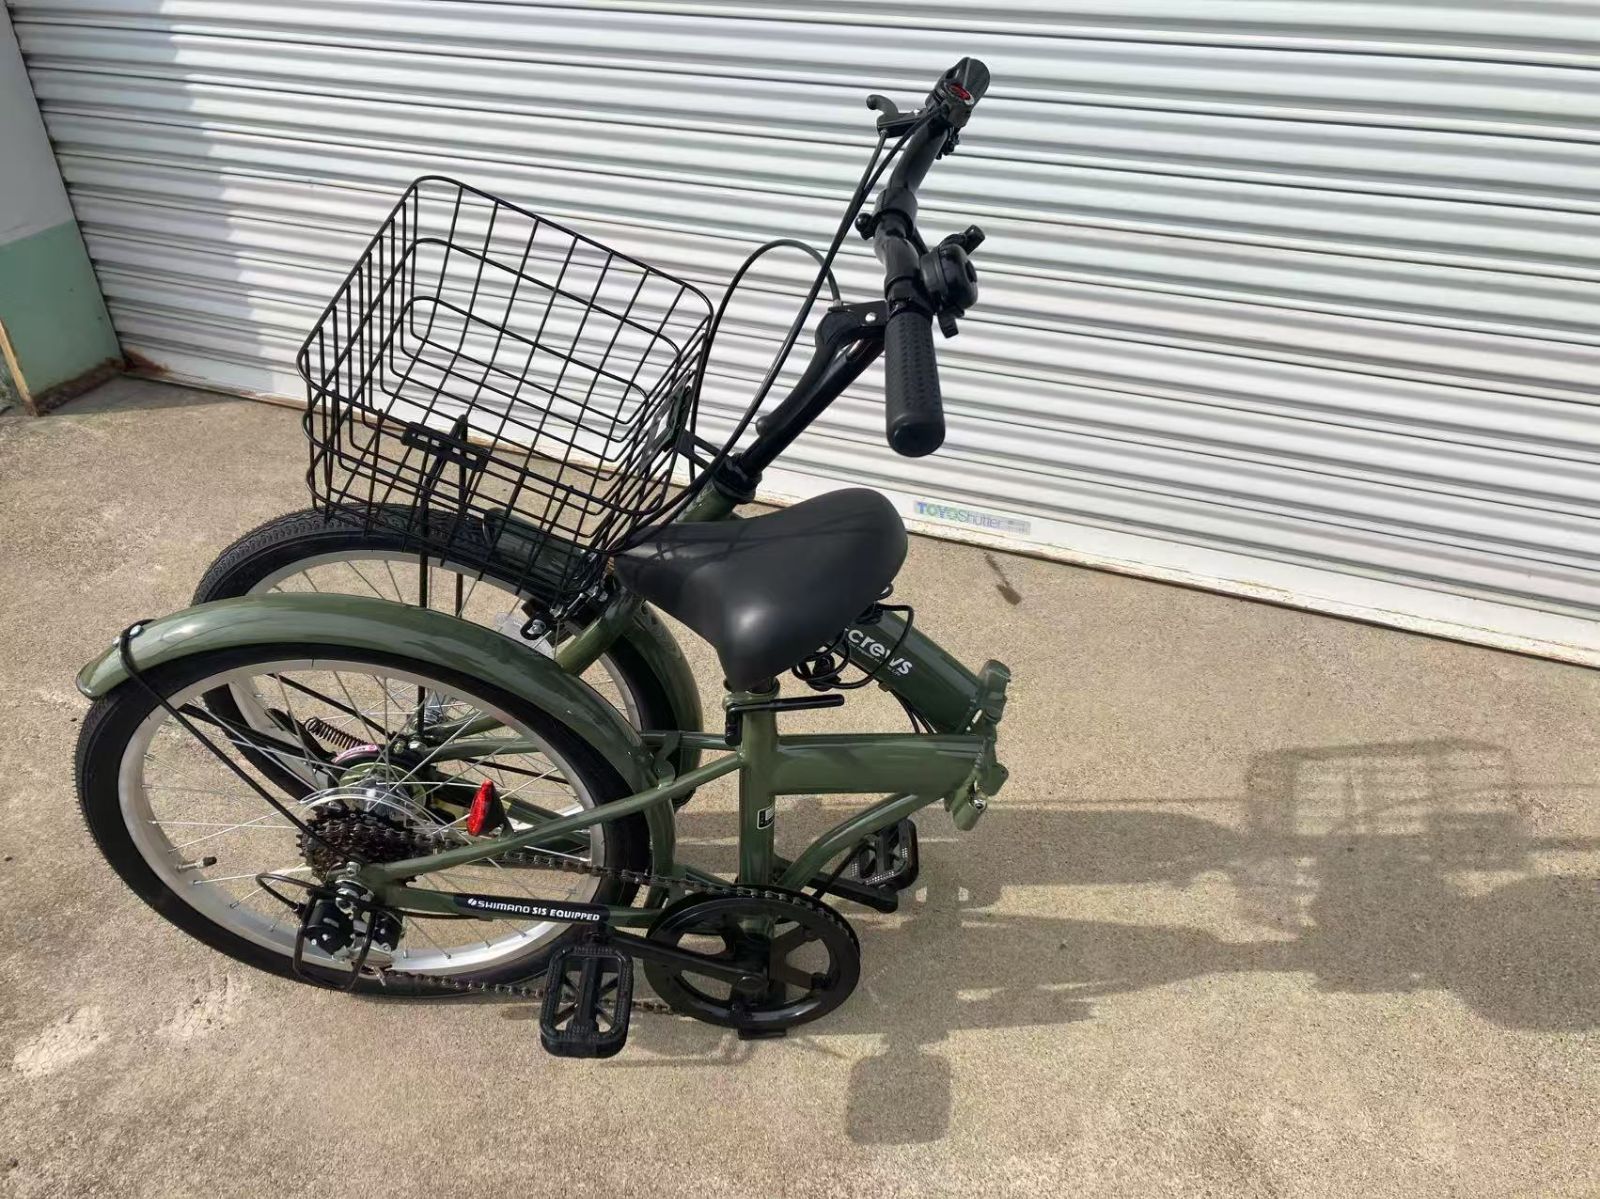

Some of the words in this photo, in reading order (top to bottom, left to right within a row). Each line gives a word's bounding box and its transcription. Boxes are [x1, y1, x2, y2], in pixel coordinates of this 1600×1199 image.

[478, 900, 530, 914] SHIMANO
[531, 906, 547, 916] SIS
[549, 908, 601, 921] EQUIPPED
